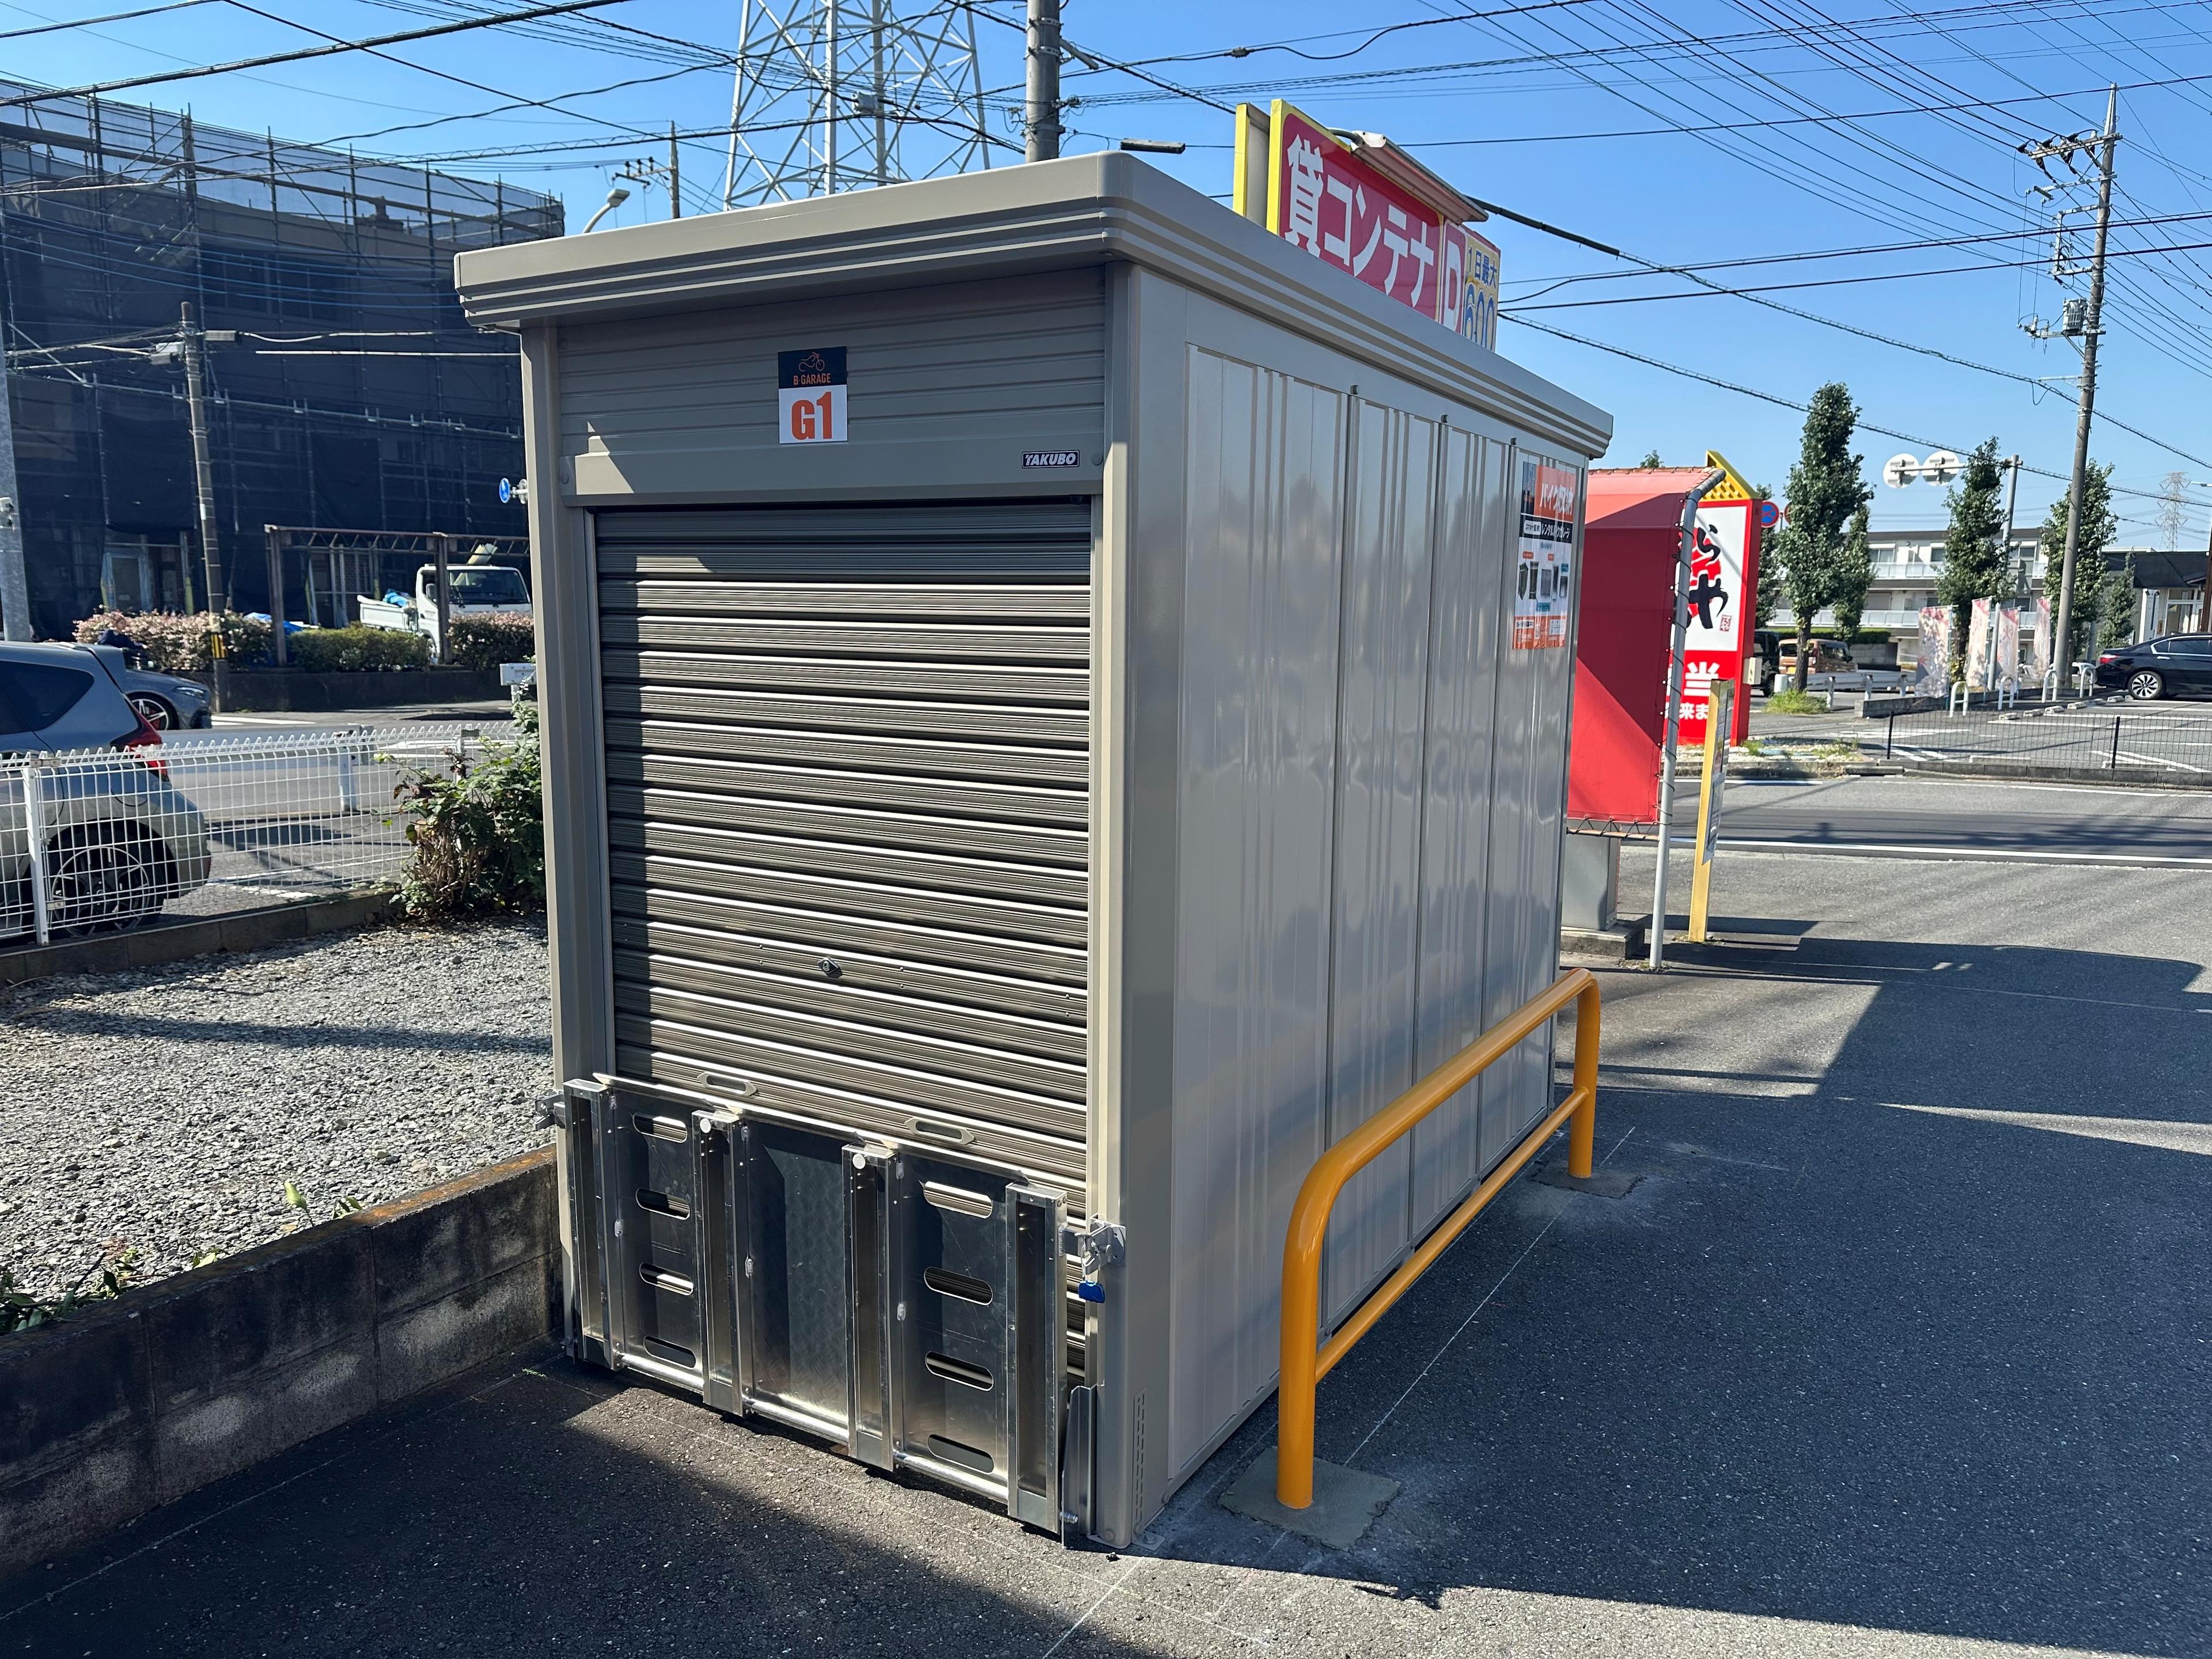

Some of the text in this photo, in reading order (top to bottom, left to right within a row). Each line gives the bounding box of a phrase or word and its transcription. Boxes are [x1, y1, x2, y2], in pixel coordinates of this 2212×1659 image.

[1285, 134, 1434, 308] 貸コンテナ
[1468, 247, 1498, 289] 1日最大
[1464, 282, 1495, 351] 600
[791, 391, 832, 440] G1
[1025, 453, 1076, 466] TAKUBO
